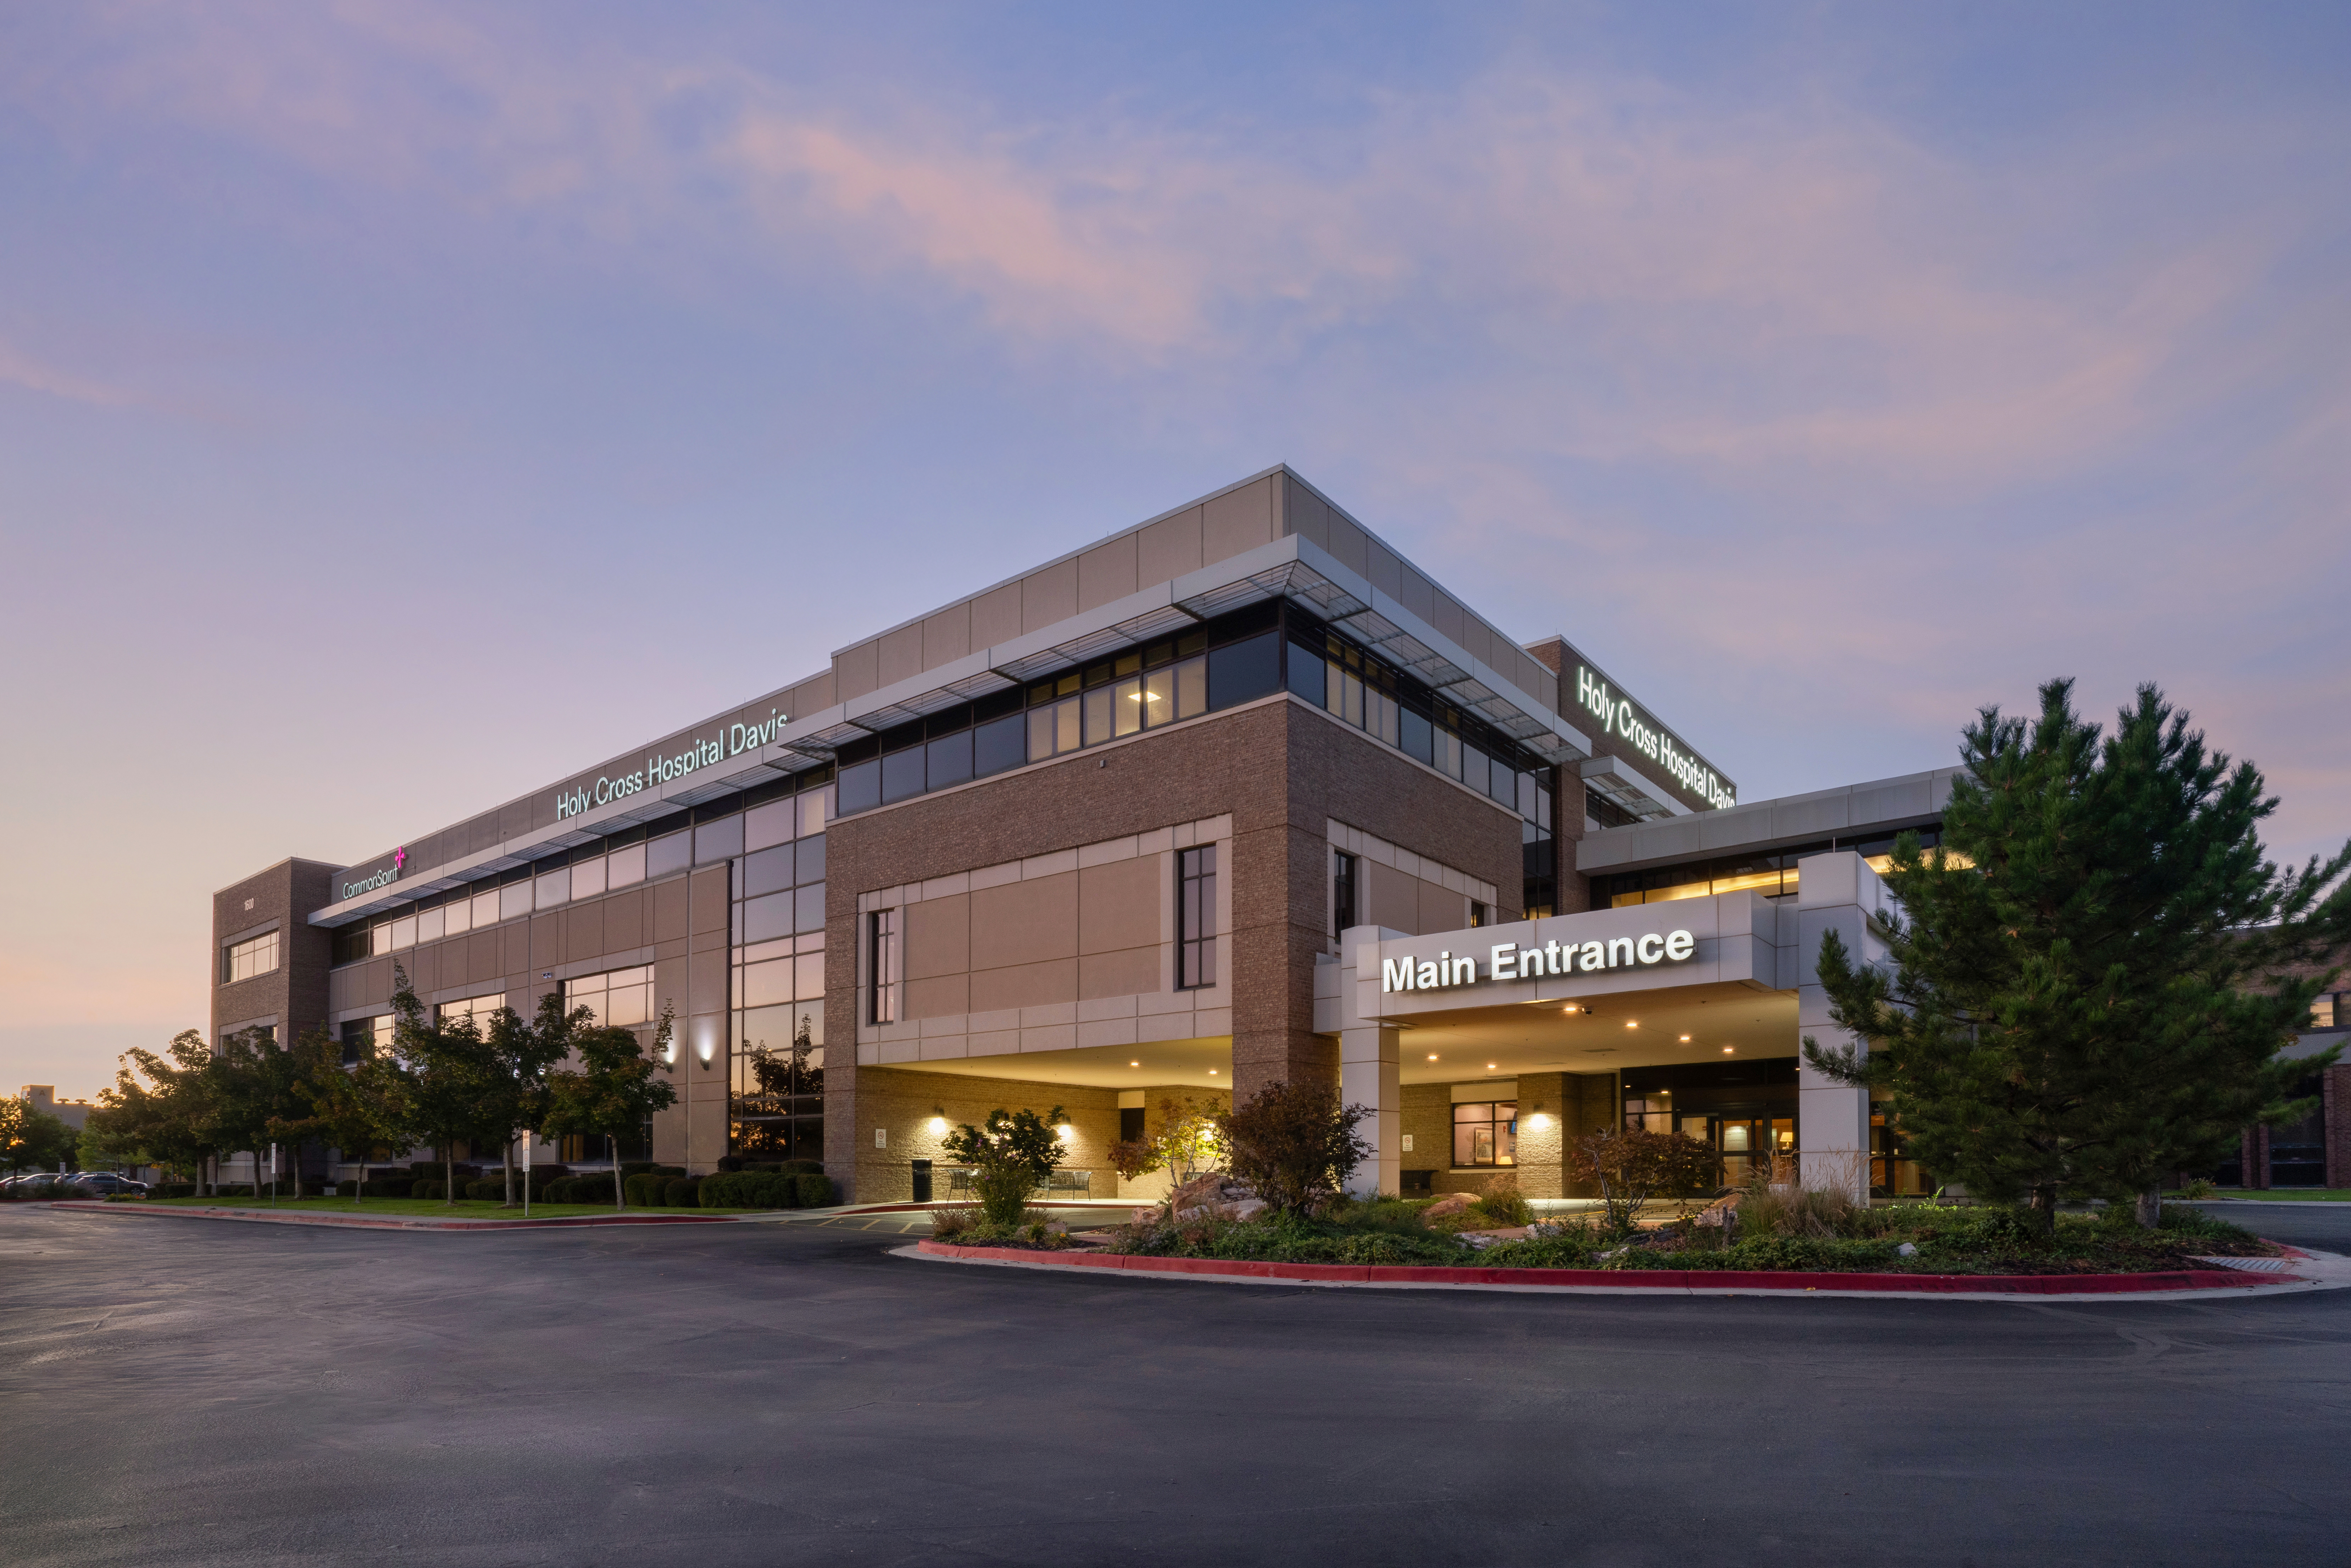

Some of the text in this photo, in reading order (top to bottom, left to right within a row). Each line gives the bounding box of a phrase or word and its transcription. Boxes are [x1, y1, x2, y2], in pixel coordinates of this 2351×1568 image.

[1580, 666, 1614, 732] Holy
[1619, 701, 1657, 759] Cross
[1661, 733, 1706, 797] Hospital
[558, 786, 591, 820] Holy
[596, 771, 643, 805] Cross
[649, 729, 723, 786] Hospital
[244, 897, 254, 911] 1600
[343, 864, 398, 899] CommonSpirit
[1383, 930, 1695, 993] Main Entrance
